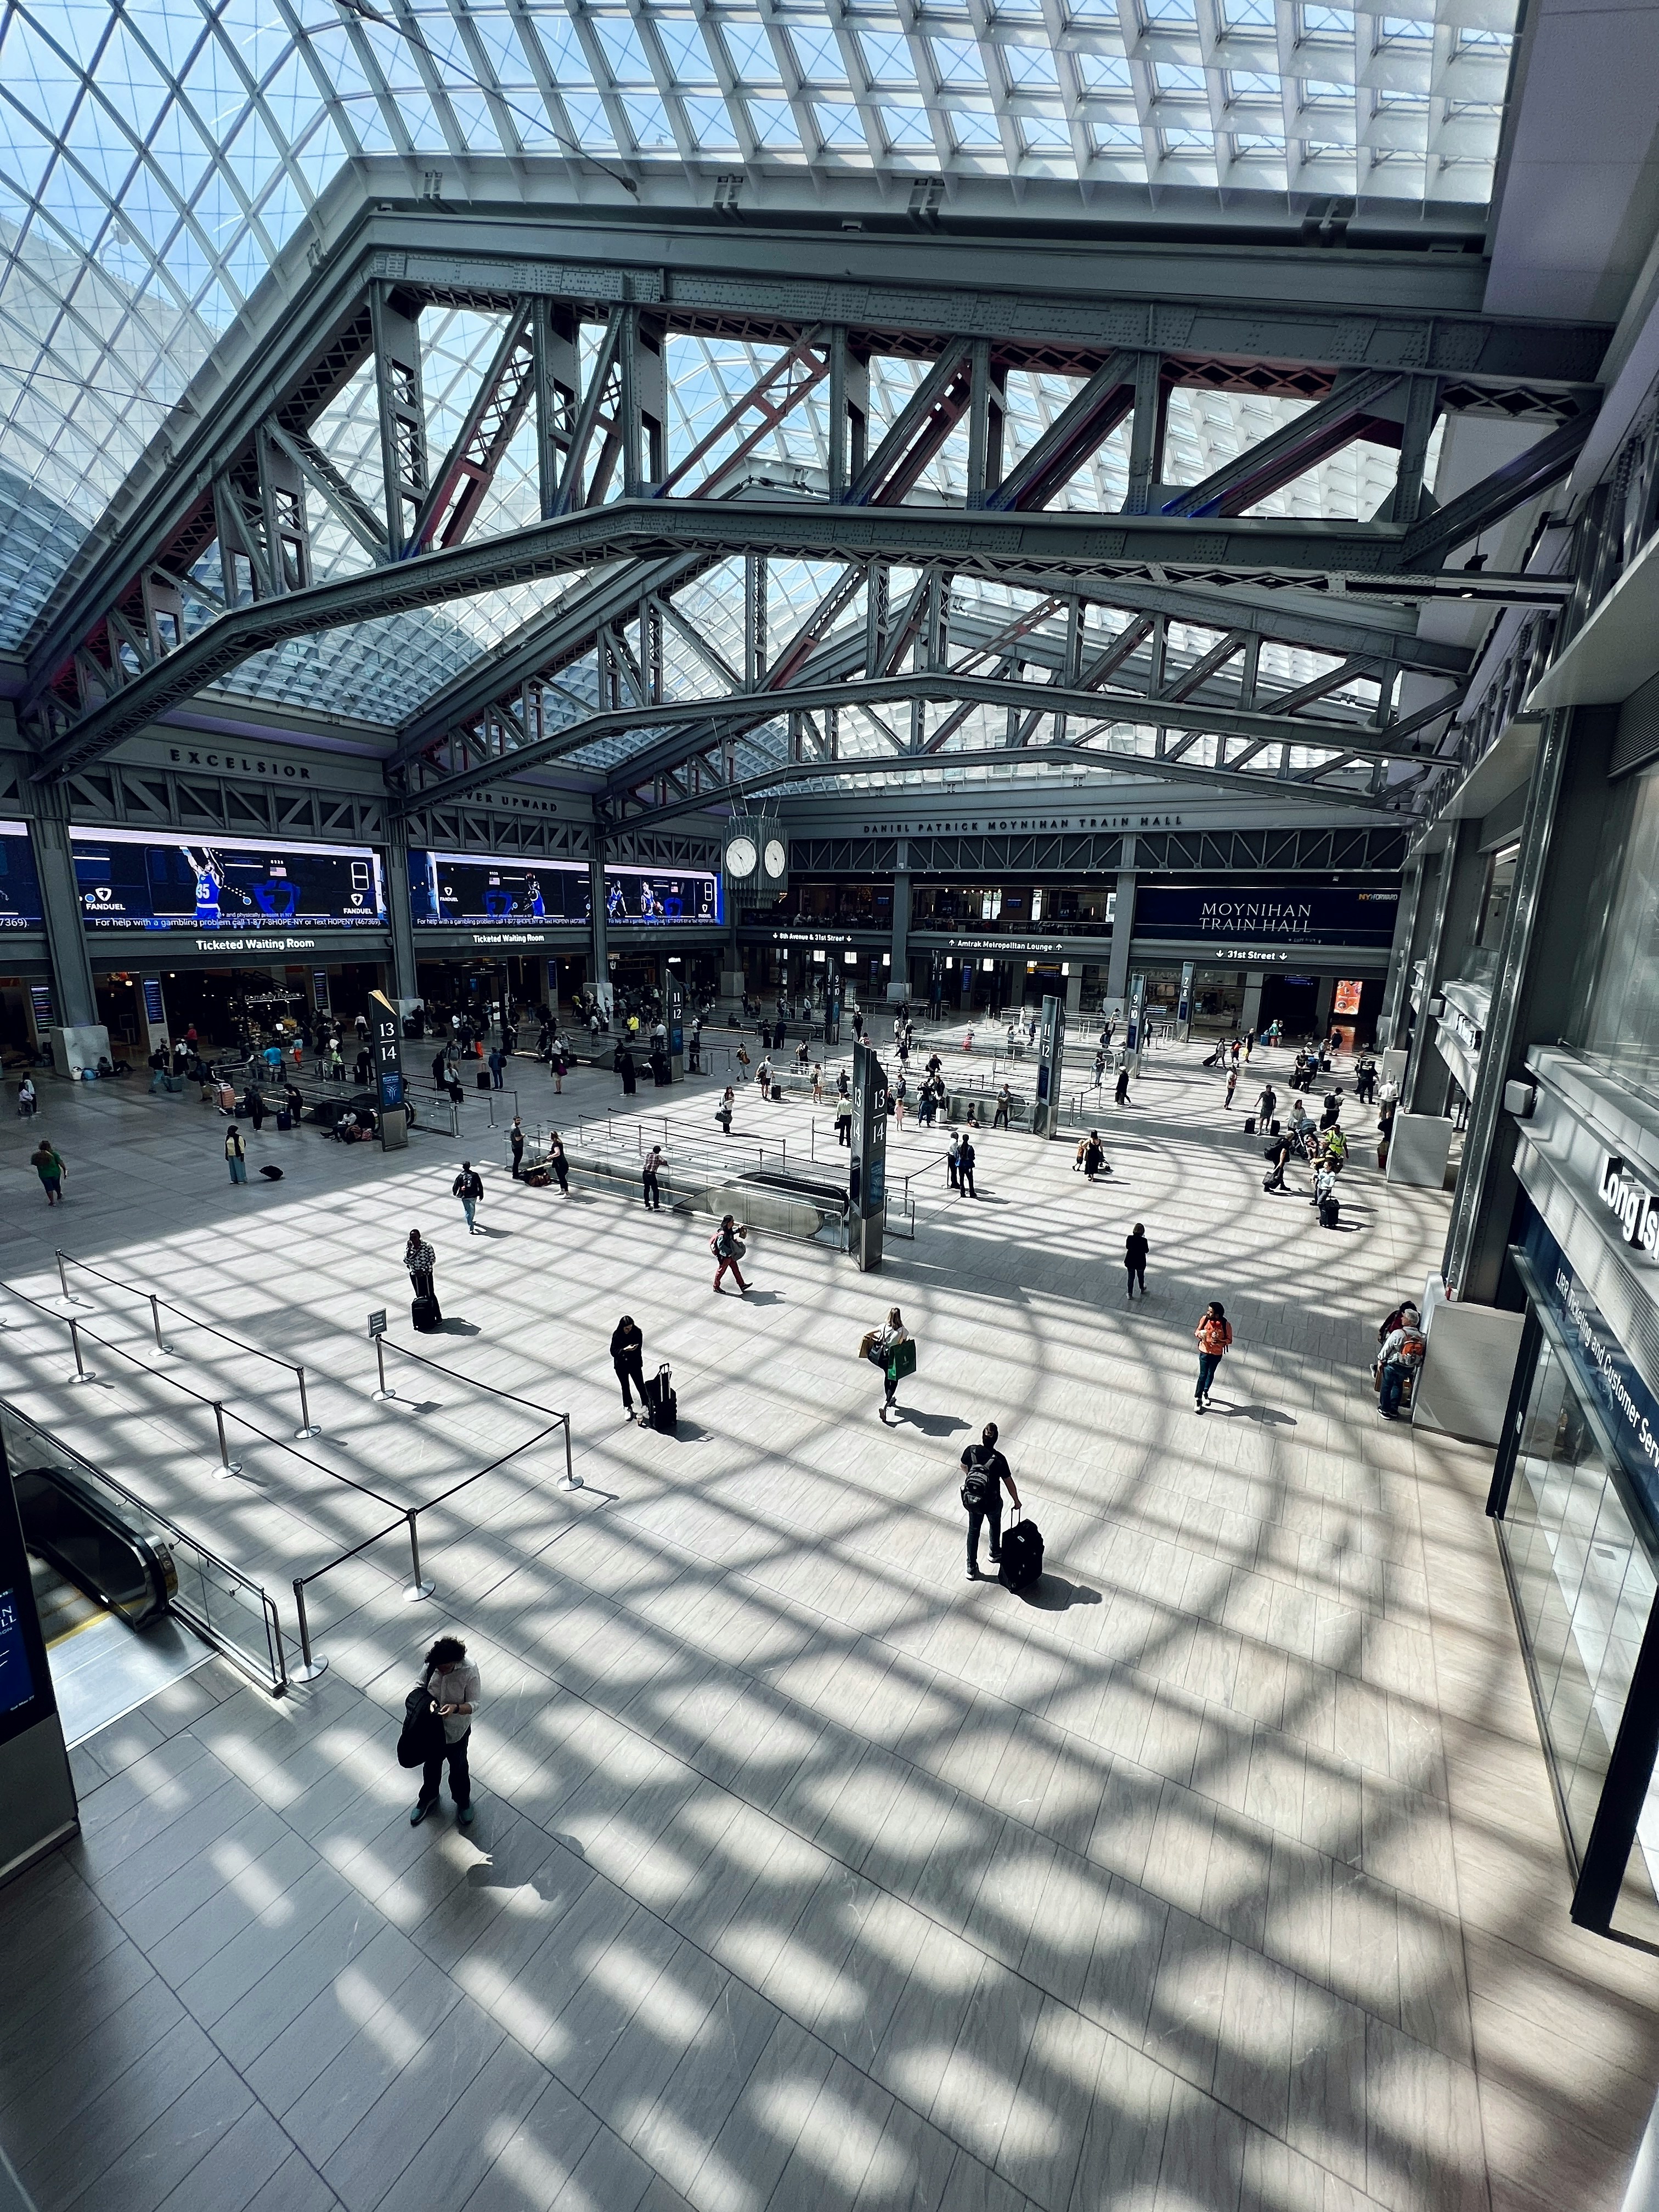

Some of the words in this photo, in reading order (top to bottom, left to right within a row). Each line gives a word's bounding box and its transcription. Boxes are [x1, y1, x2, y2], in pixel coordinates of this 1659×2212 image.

[170, 749, 310, 779] EXCELSIOR
[466, 791, 493, 803] VER
[501, 796, 557, 812] UPWARD
[864, 824, 910, 833] DANIEL
[918, 822, 978, 833] PATRICK
[988, 819, 1069, 831] MOYNIHAN
[1079, 817, 1129, 828] TRAIN
[1140, 816, 1182, 827] HALL
[1201, 902, 1312, 917] MOYNIHAN
[95, 918, 110, 927] For
[110, 918, 132, 927] help
[132, 918, 151, 927] with
[161, 918, 198, 928] gambling
[199, 918, 231, 927] problem
[1199, 917, 1256, 932] TRAIN
[1261, 919, 1312, 933] HALL
[195, 940, 243, 950] Ticketed
[245, 939, 285, 950] Waiting
[286, 938, 315, 948] Room
[472, 934, 501, 943] Ticketed
[502, 934, 526, 943] Waiting
[957, 940, 982, 948] Amtrak
[983, 940, 1025, 950] Metropolitan
[1026, 943, 1053, 952] Lounge
[1227, 950, 1246, 959] 31st
[1248, 951, 1276, 960] Street
[835, 975, 839, 983] 9
[1184, 977, 1189, 985] 7
[673, 992, 680, 1003] 11
[1133, 994, 1138, 1004] 9
[1182, 989, 1187, 997] 8
[673, 1008, 681, 1019] 12
[1131, 1009, 1138, 1019] 10
[379, 1022, 395, 1037] 13
[1043, 1023, 1051, 1037] 11
[1059, 1025, 1064, 1038] 11
[381, 1045, 397, 1062] 14
[1041, 1044, 1050, 1058] 12
[1057, 1046, 1063, 1059] 12
[854, 1086, 862, 1108] 13
[873, 1088, 885, 1110] 13
[853, 1119, 861, 1142] 14
[873, 1122, 884, 1144] 14
[1598, 1154, 1640, 1242] Long
[1555, 1267, 1570, 1301] LIRR
[1567, 1288, 1593, 1348] Ticketing
[1591, 1336, 1606, 1365] and
[1604, 1353, 1641, 1428] Customer
